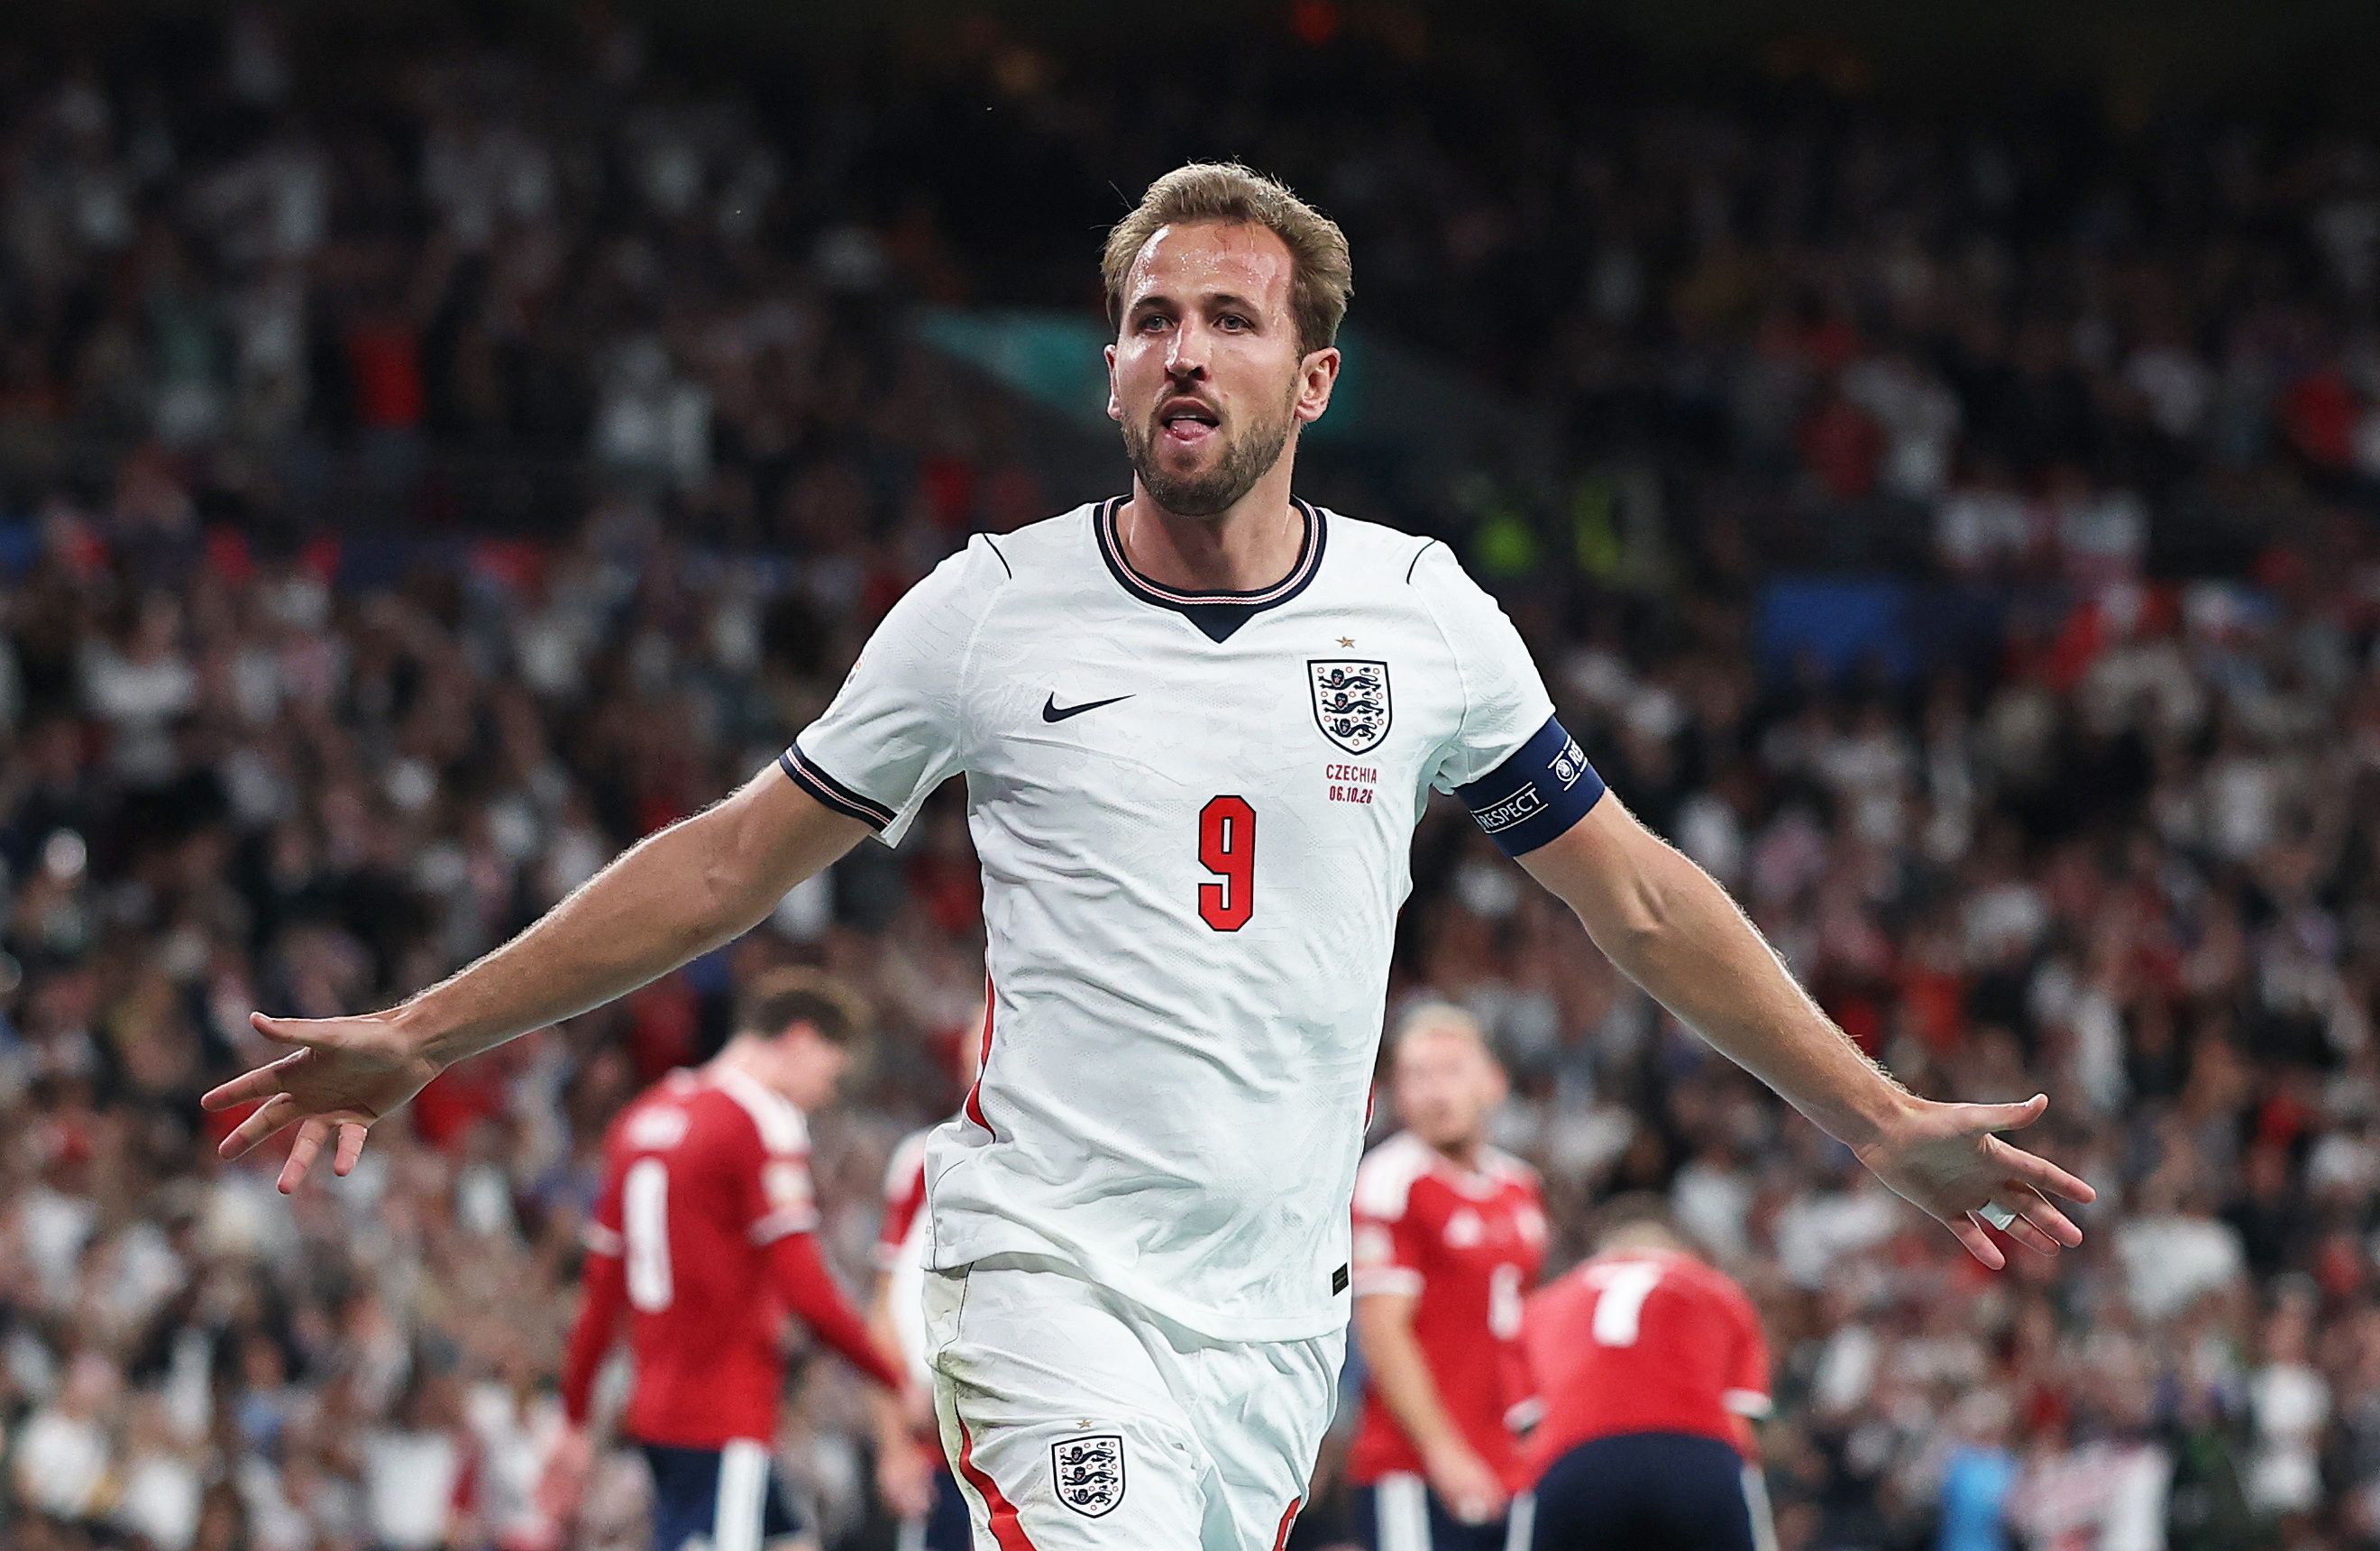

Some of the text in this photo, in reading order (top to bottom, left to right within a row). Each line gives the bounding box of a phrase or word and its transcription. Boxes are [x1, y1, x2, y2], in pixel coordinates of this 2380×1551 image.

[1326, 764, 1378, 784] CZECHIA
[1329, 785, 1373, 804] 06.10.26
[1478, 787, 1540, 829] RESPECT
[1198, 795, 1257, 932] 9
[1584, 1262, 1661, 1345] 7
